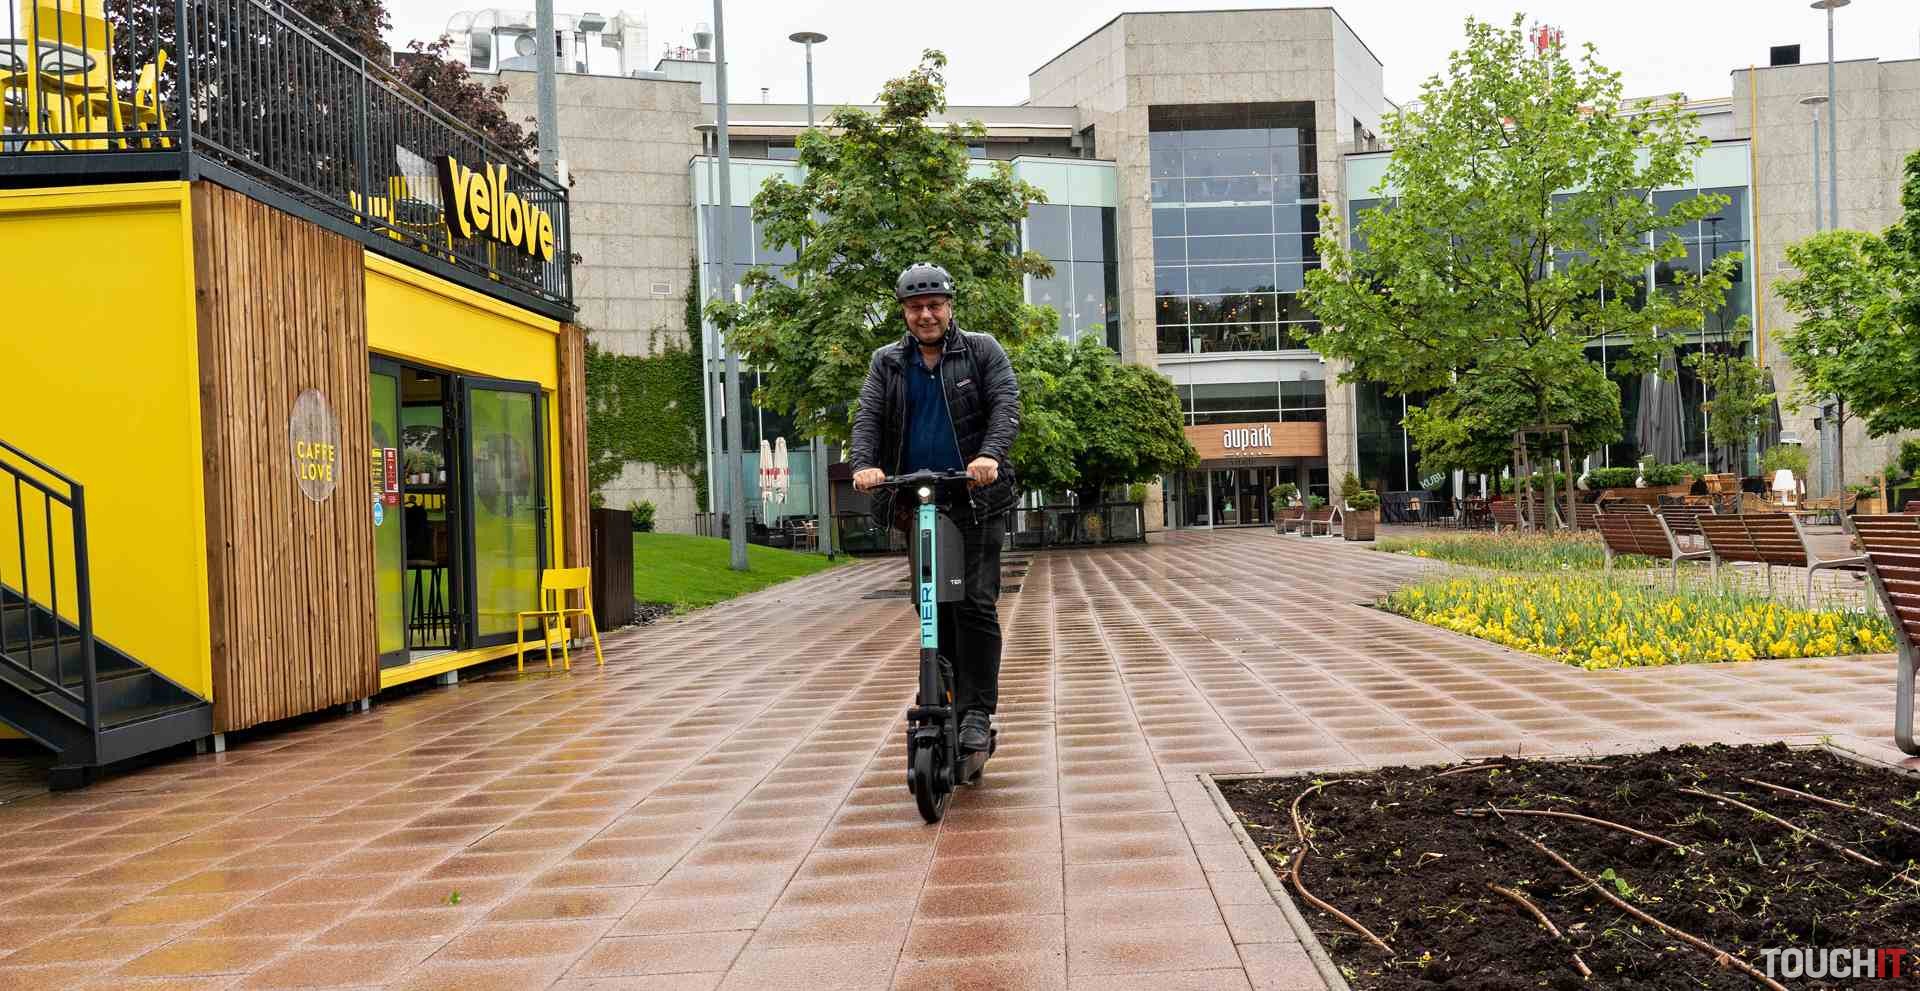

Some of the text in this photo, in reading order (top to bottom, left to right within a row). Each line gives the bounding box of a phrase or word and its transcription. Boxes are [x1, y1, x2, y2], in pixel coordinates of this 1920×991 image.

[1223, 424, 1272, 451] aupark
[297, 441, 335, 462] CAFFE
[301, 463, 333, 482] LOVE
[921, 586, 933, 645] TIER
